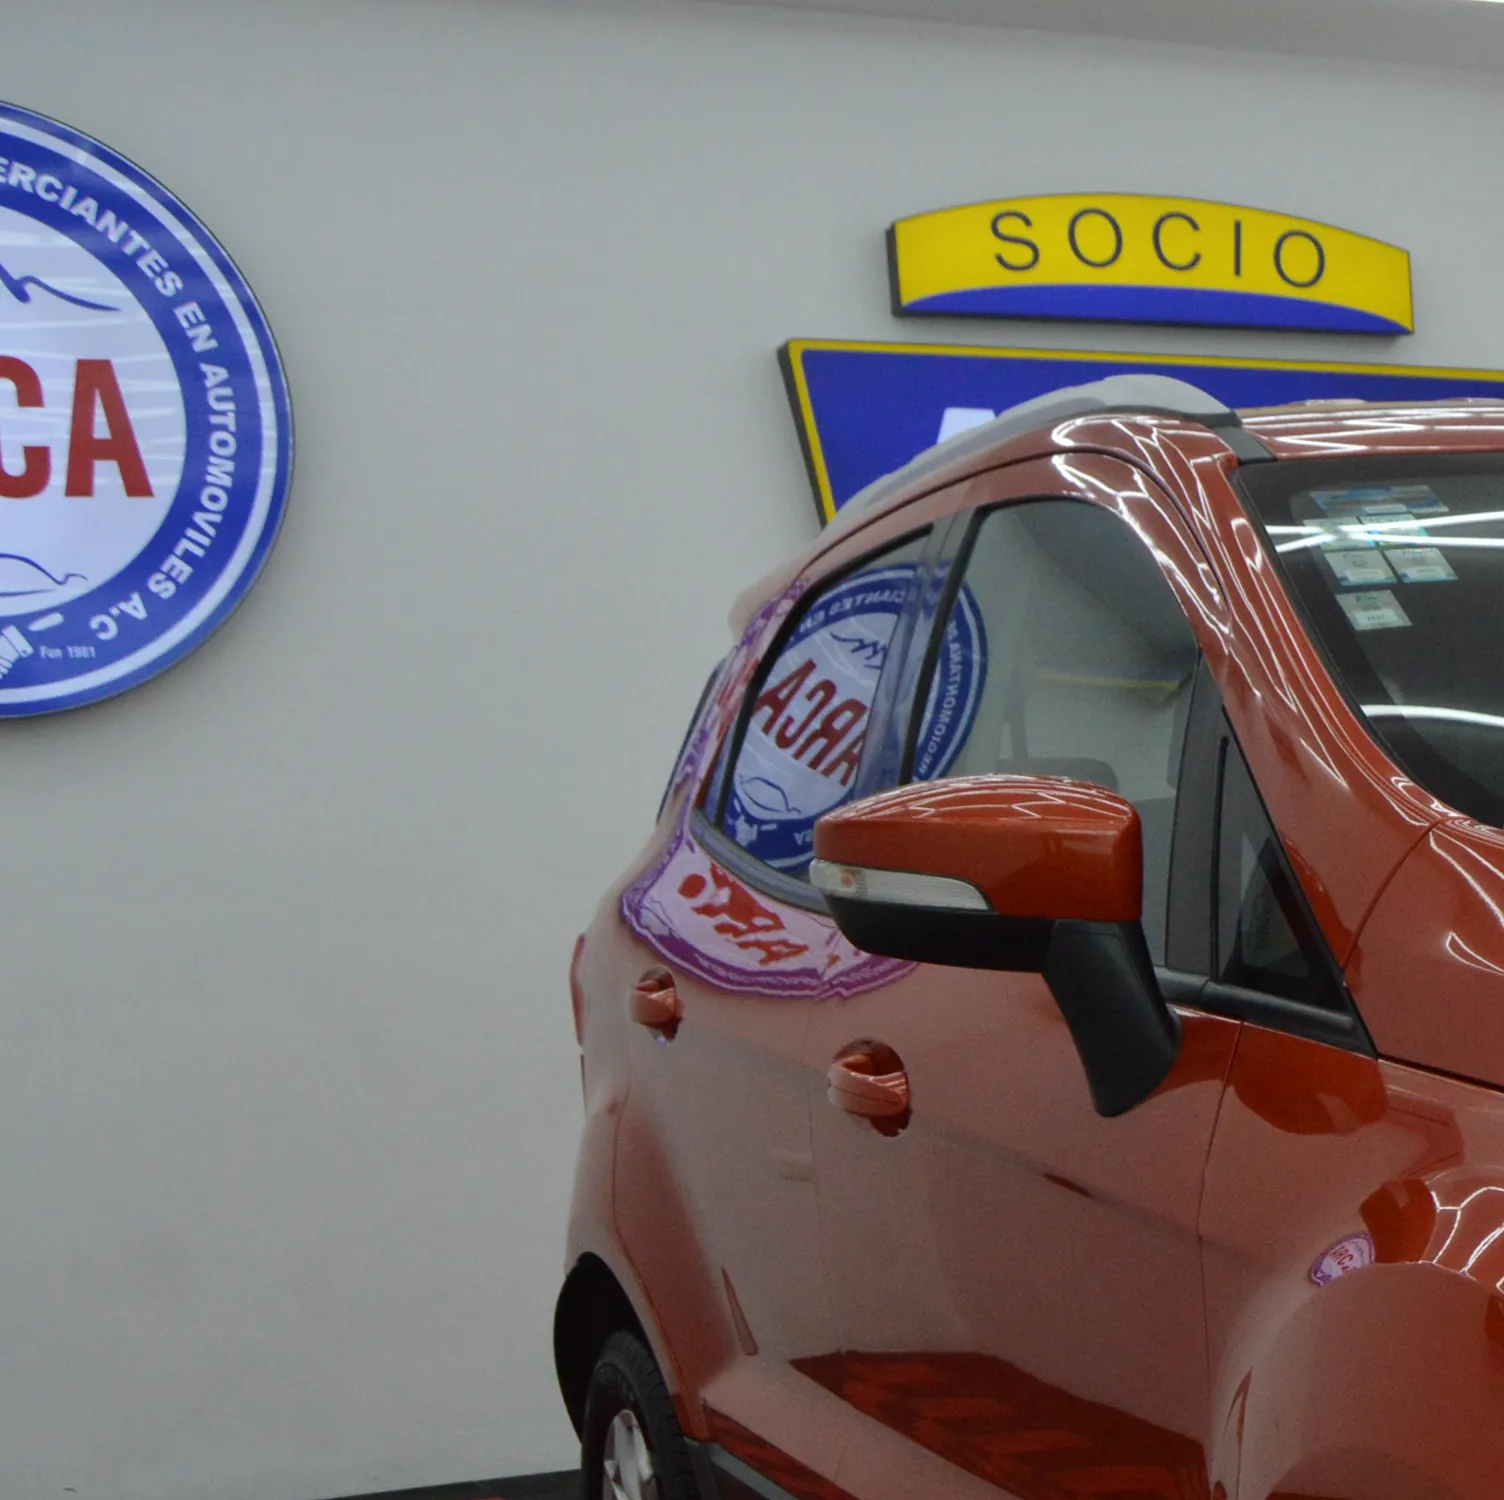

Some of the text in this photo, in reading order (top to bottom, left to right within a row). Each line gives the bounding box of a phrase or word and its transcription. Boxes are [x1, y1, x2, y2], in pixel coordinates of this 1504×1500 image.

[990, 207, 1325, 288] SOCIO
[173, 300, 218, 353] EN
[147, 362, 237, 600] AUTOMOVILES
